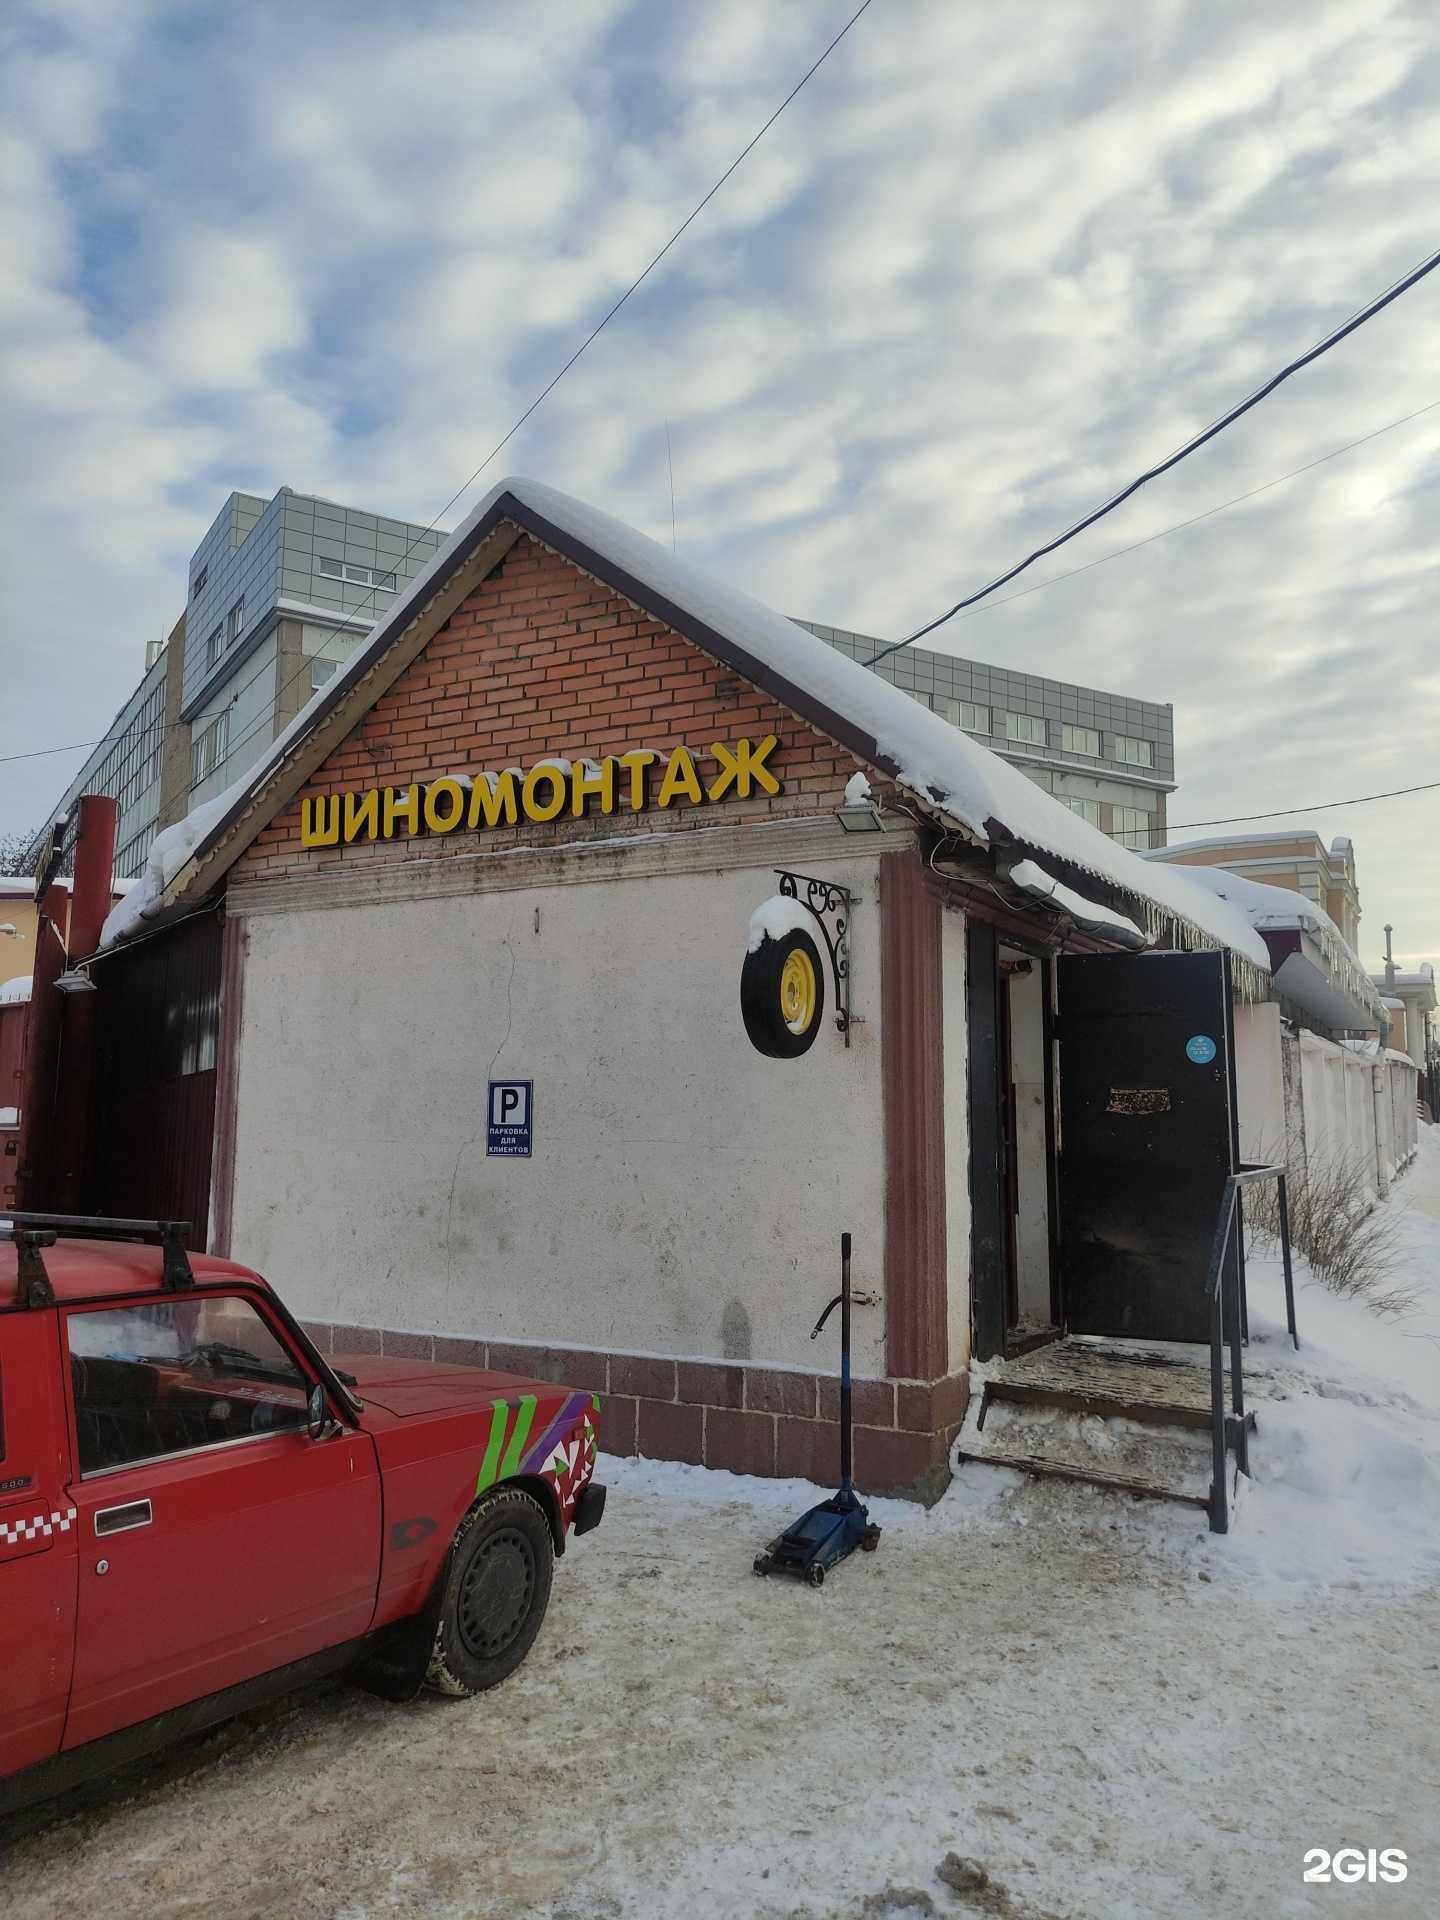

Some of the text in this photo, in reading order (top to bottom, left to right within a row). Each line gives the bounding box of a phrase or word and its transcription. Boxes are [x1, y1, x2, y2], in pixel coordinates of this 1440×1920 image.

[301, 734, 783, 848] ШИНОМОНТАЖ
[501, 1089, 519, 1123] P
[501, 1137, 516, 1145] ДЛЯ
